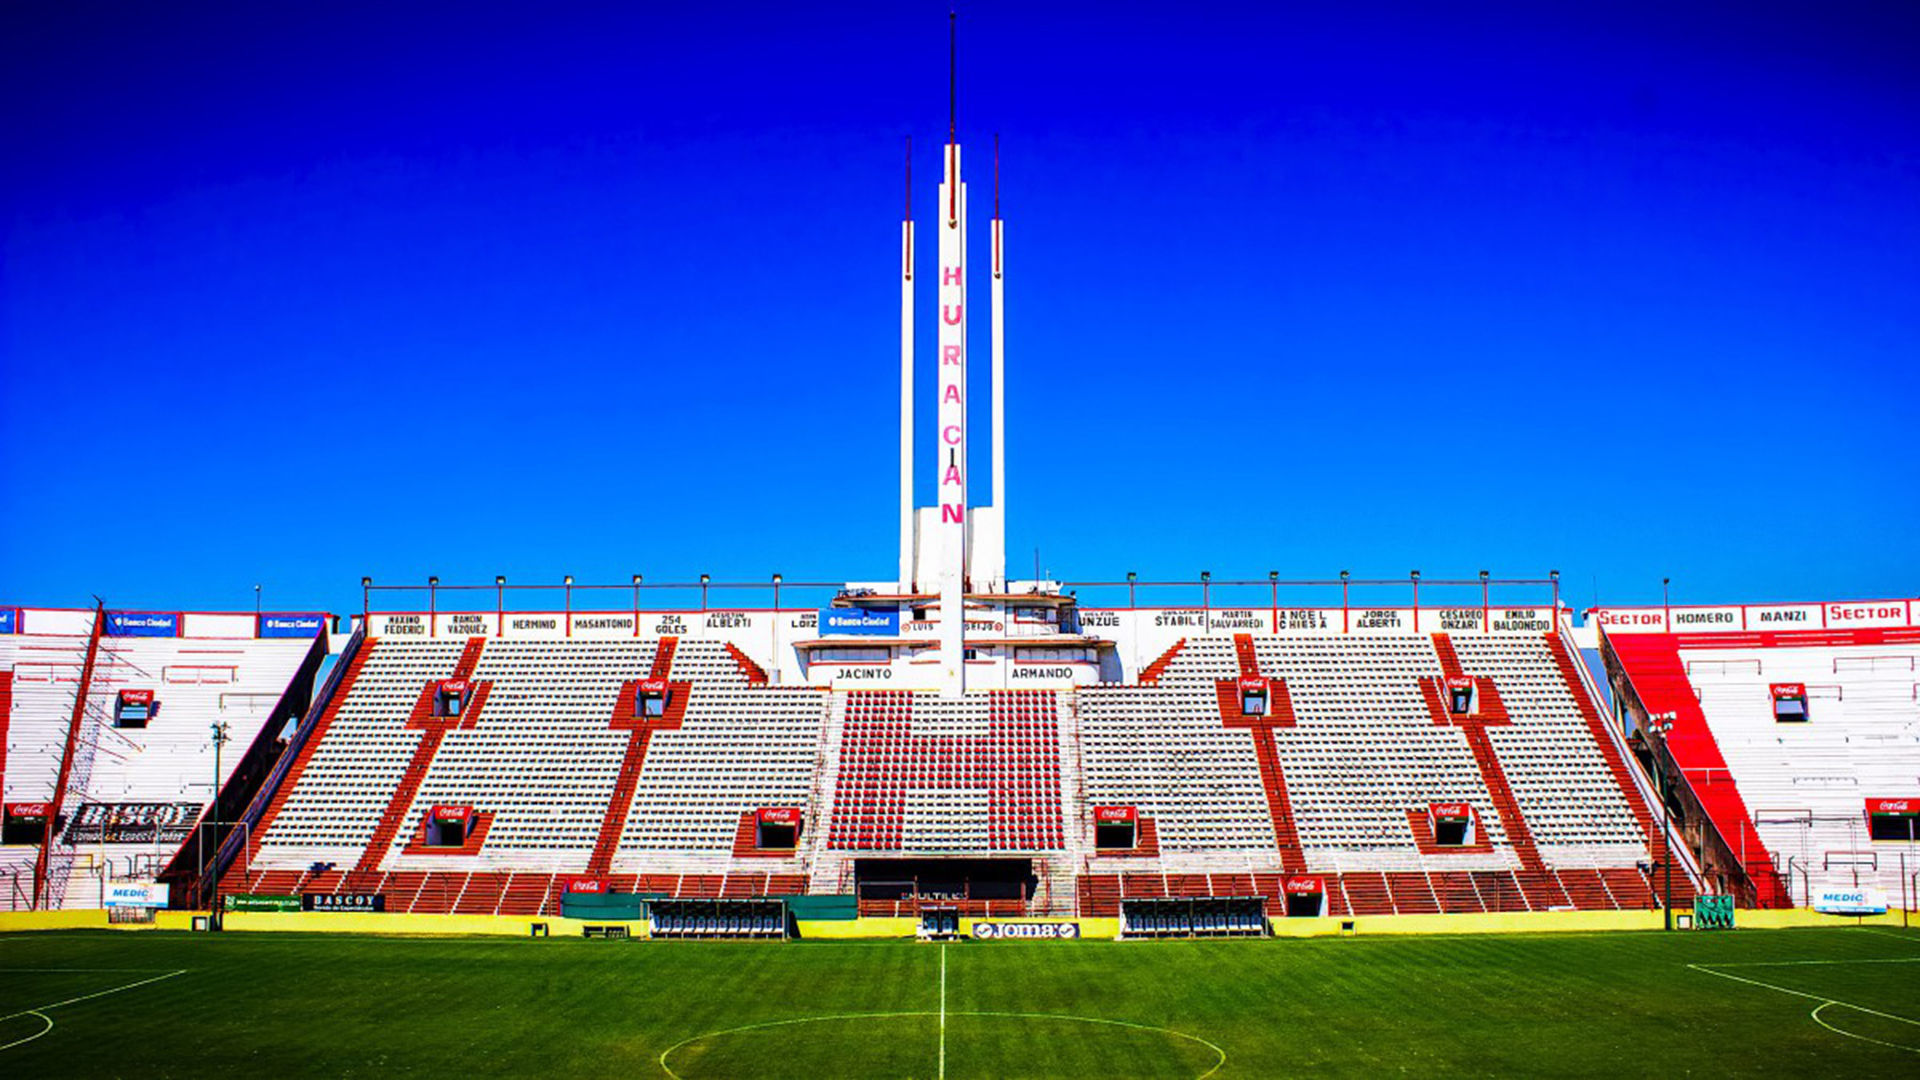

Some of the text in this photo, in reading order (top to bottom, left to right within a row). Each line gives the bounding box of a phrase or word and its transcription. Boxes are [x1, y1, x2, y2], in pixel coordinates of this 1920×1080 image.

[1362, 610, 1397, 618] JORGE
[1439, 610, 1483, 620] CESAREO
[1505, 610, 1536, 619] EMILIO
[1676, 611, 1806, 624] HOMERO MANZI
[512, 619, 633, 629] HERMINIO MASANTONIO
[661, 615, 682, 624] 254
[706, 618, 752, 628] ALBERTI
[1078, 617, 1120, 627] UNZUE
[1155, 616, 1205, 626] STABILE
[1356, 619, 1401, 628] ALBERTI
[384, 624, 425, 634] FEDERICI
[447, 624, 488, 634] VAZQUEZ
[655, 625, 687, 634] GOLES
[913, 623, 934, 631] LUIS
[1441, 620, 1478, 630] ONZARI
[1493, 620, 1550, 631] BALDONEDO
[836, 667, 1073, 679] JACINTO ARMANDO
[313, 895, 375, 905] BASCOY
